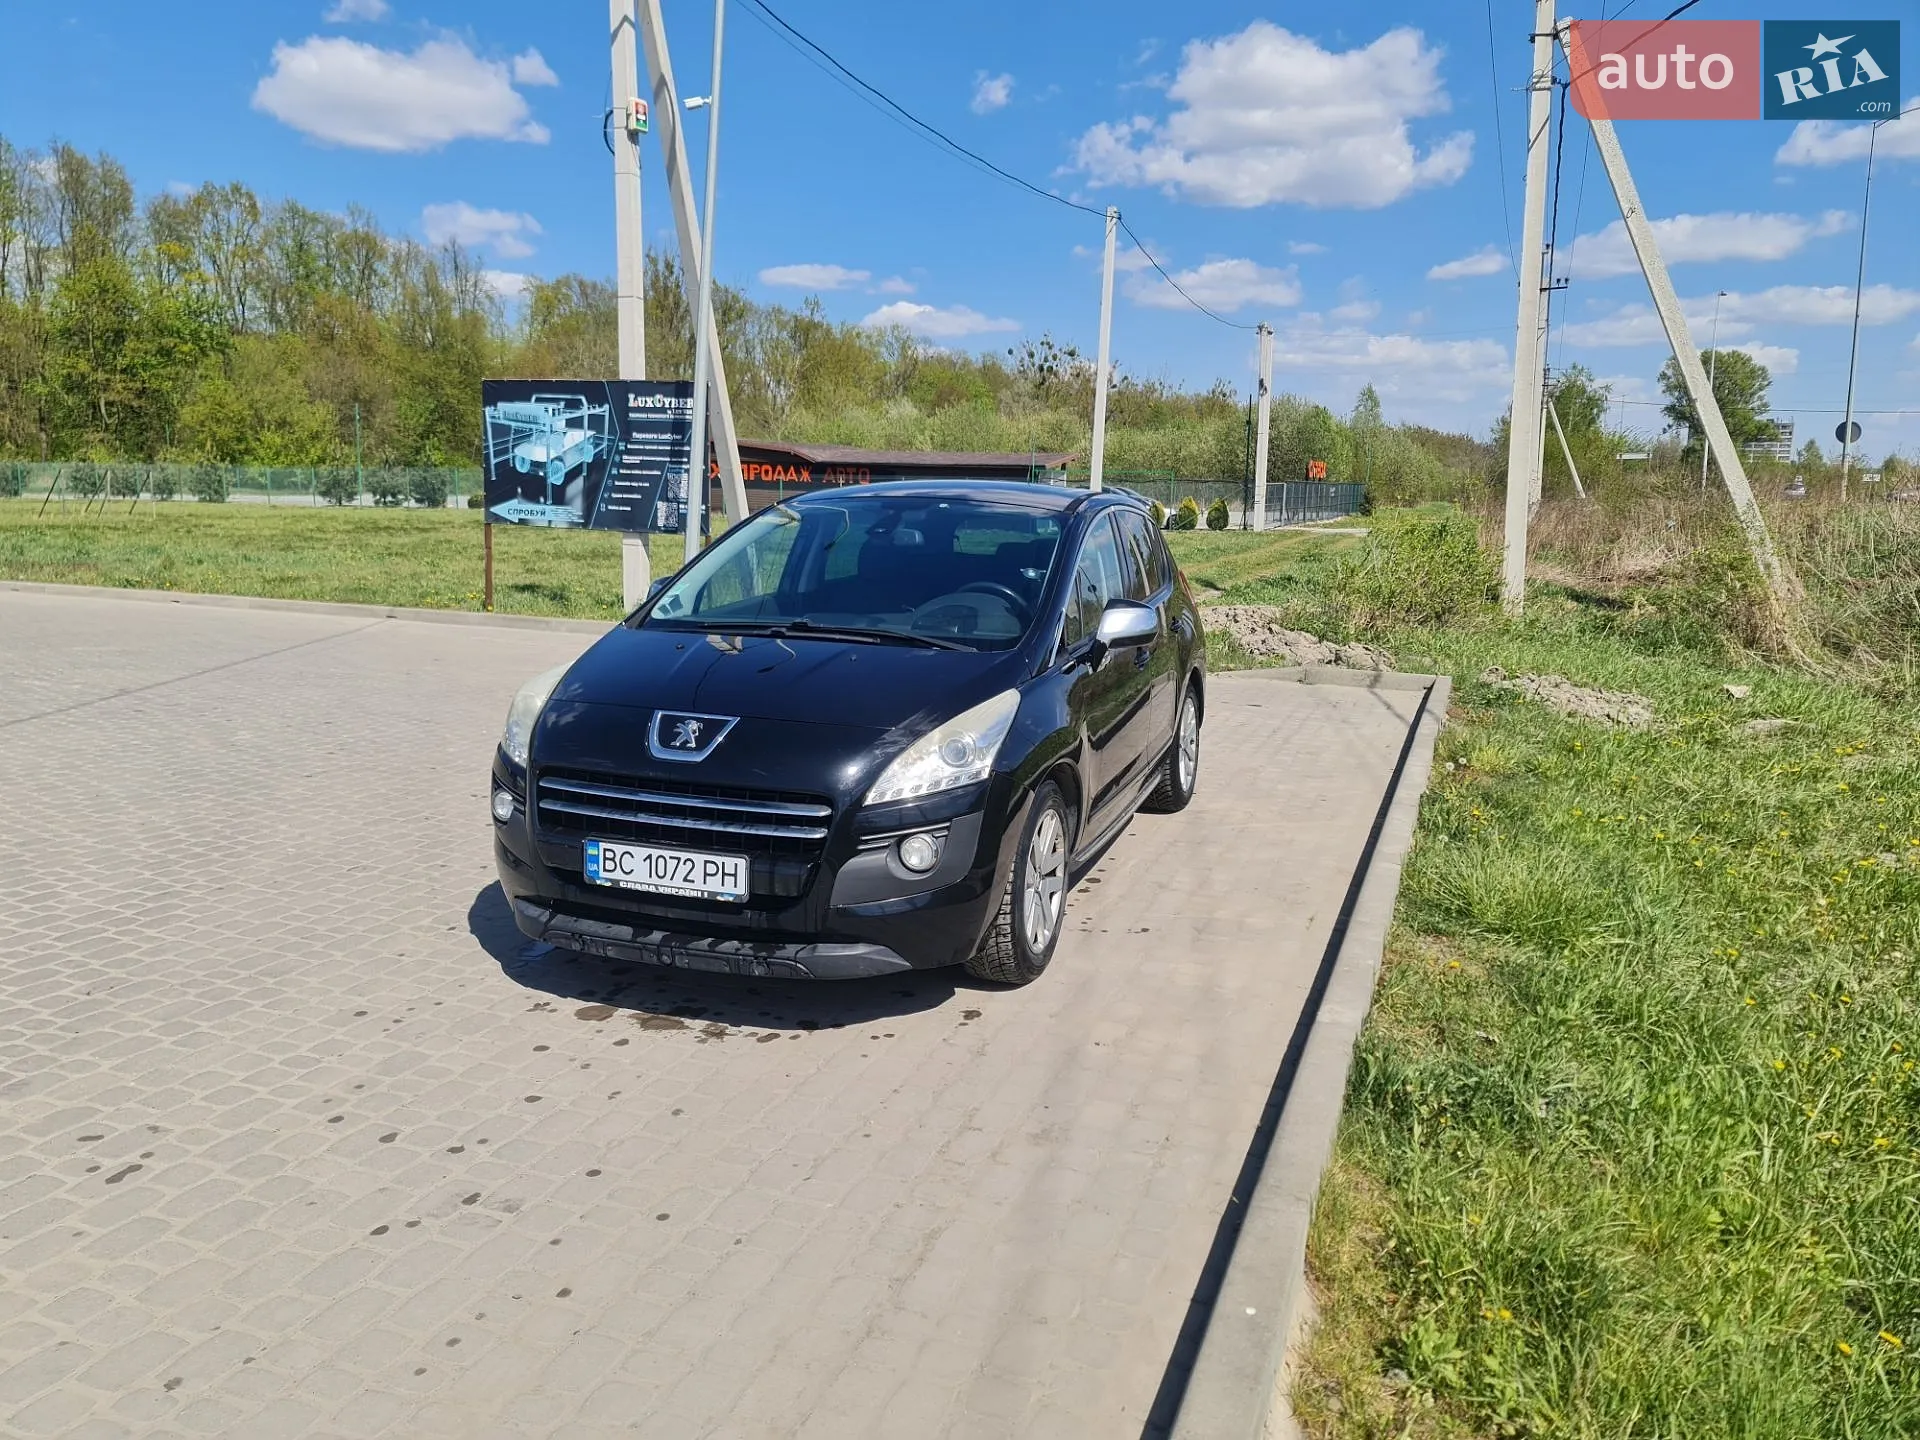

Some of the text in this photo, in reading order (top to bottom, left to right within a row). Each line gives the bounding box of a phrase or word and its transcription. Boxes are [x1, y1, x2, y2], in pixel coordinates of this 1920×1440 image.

[507, 507, 546, 517] СПРОБУЙ
[588, 863, 599, 872] UA
[602, 847, 738, 889] BC 1072 PH
